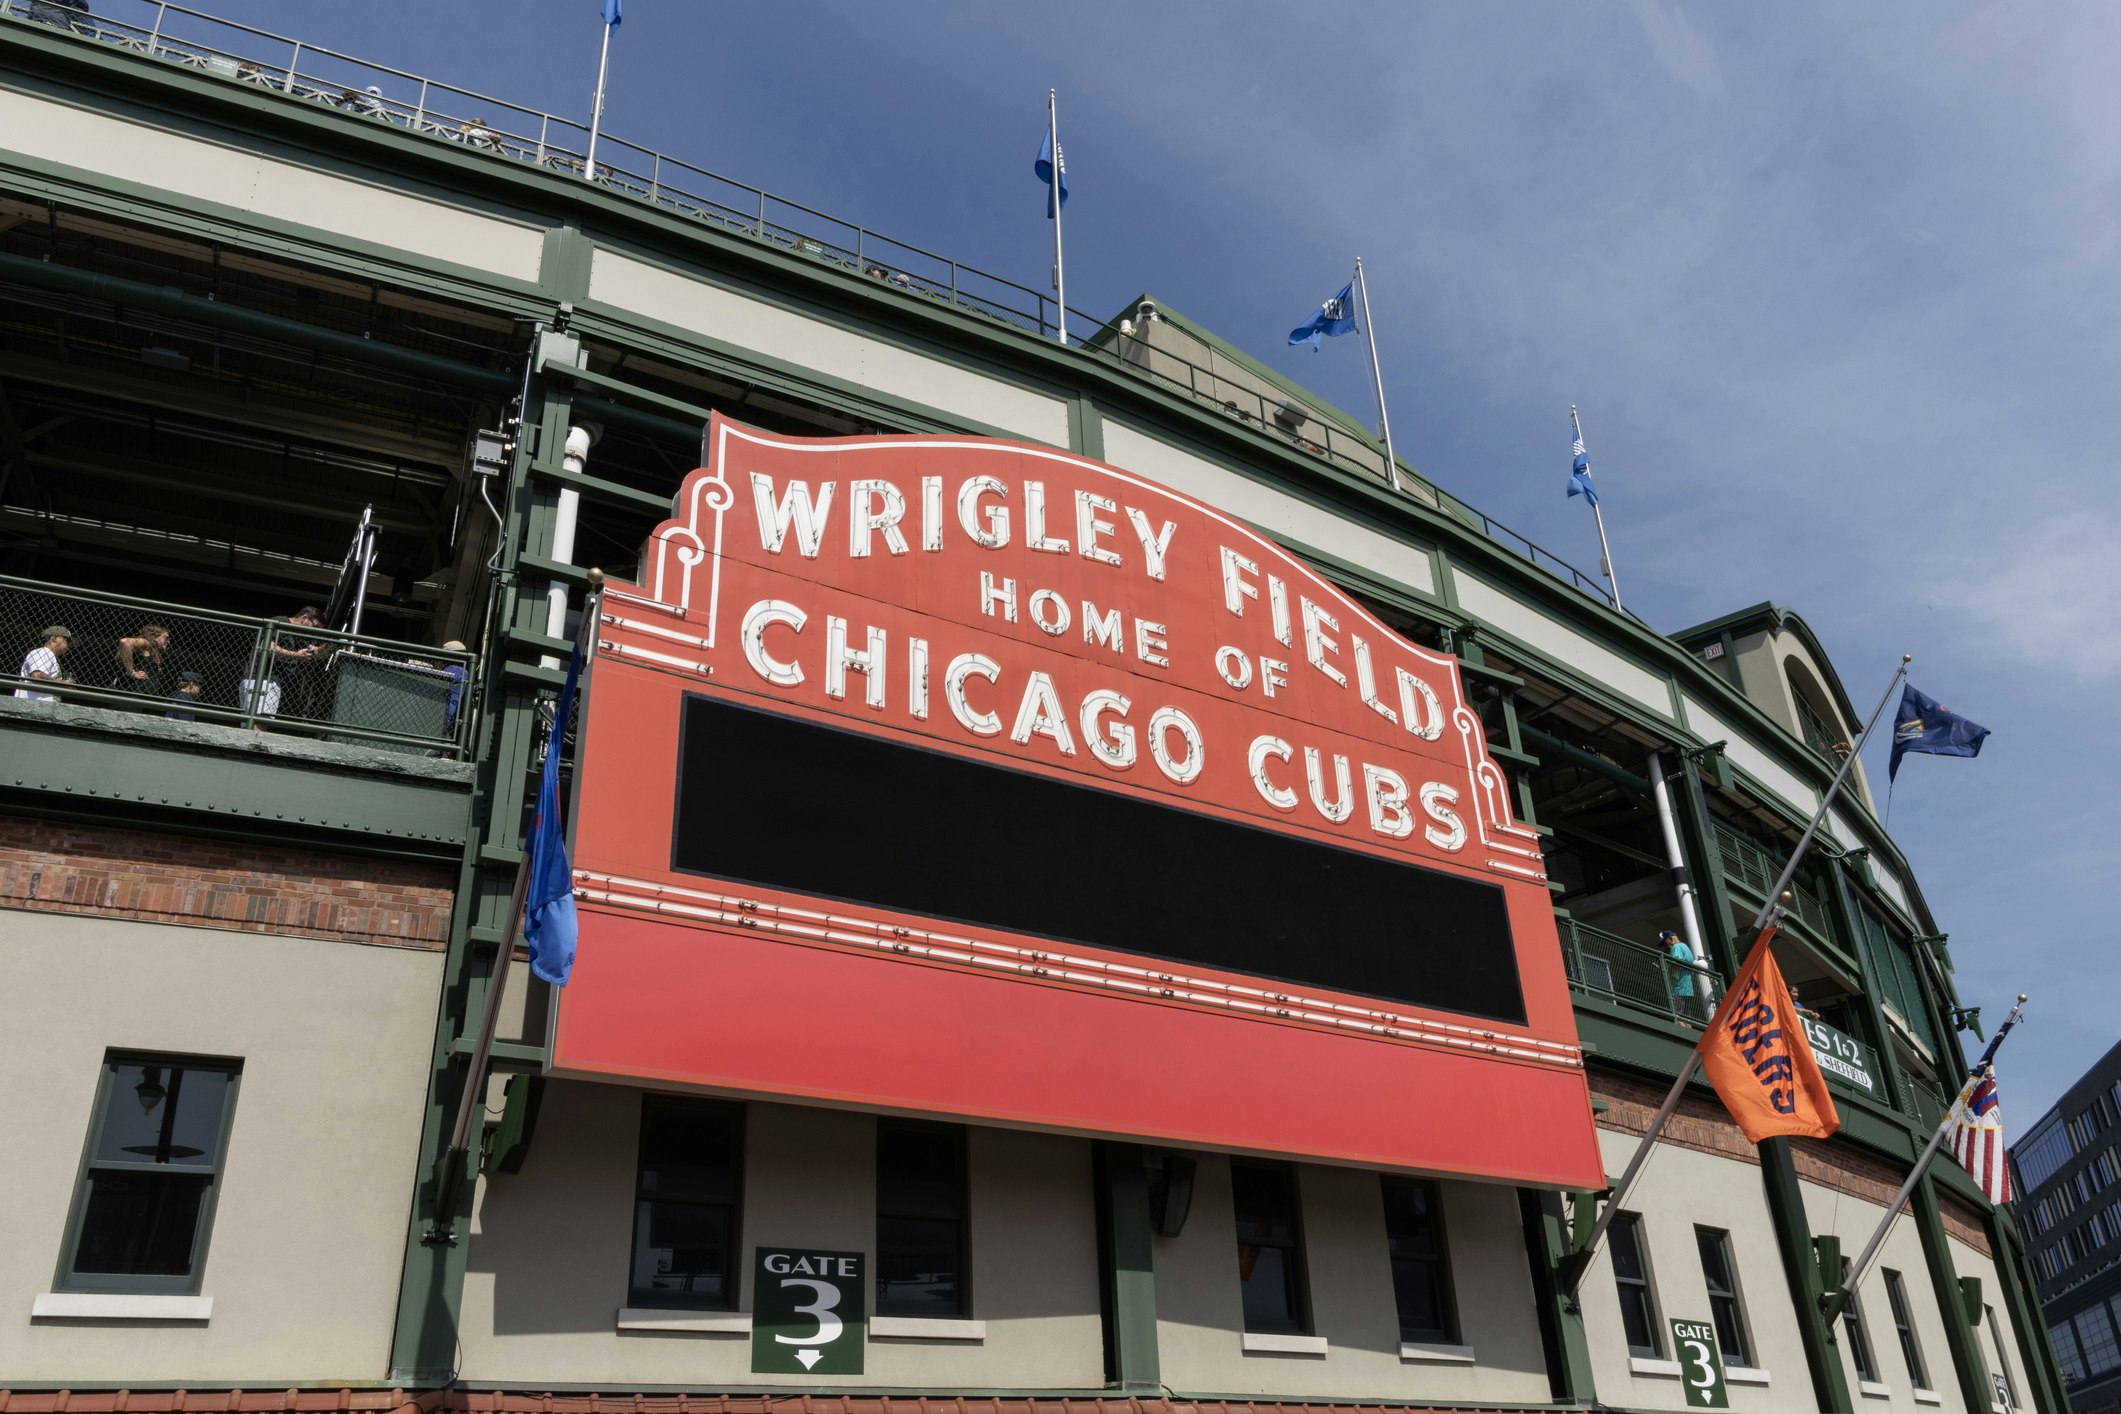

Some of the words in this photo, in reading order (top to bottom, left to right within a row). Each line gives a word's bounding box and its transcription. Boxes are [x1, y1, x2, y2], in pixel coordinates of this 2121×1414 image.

[750, 471, 1177, 581] WRIGLEY
[1220, 545, 1445, 741] FIELD
[980, 571, 1169, 668] HOME
[1215, 645, 1288, 698] OF
[1706, 645, 1721, 658] EXIT
[741, 599, 1205, 784] CHICAGO
[1248, 735, 1468, 852] CUBS
[1824, 1055, 1868, 1085] SHEFFIELD
[764, 1254, 857, 1277] GATE
[775, 1278, 843, 1345] 3
[1674, 1323, 1712, 1340] GATE
[1684, 1340, 1716, 1388] 3
